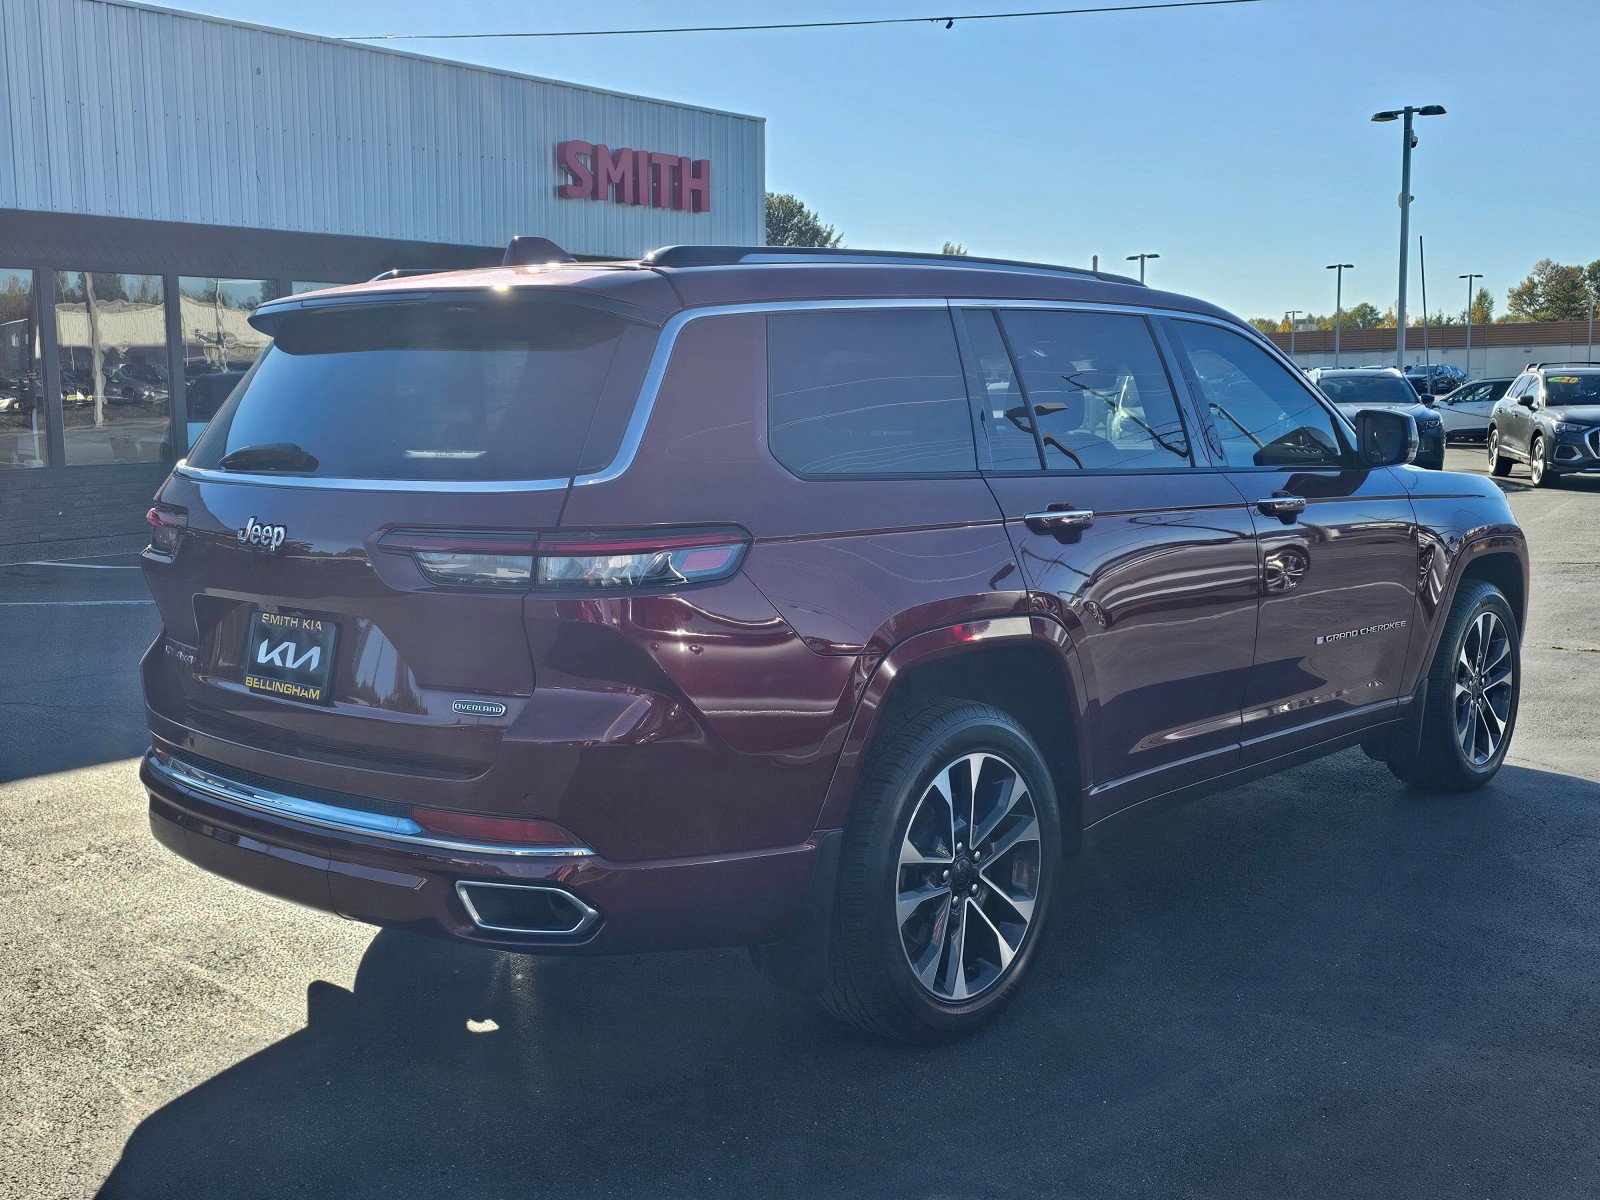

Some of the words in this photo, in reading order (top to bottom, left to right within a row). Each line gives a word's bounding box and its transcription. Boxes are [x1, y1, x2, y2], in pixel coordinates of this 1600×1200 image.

[557, 140, 710, 212] SMITH
[237, 516, 287, 552] Jeep
[261, 613, 299, 628] SMITH
[302, 618, 322, 631] KIA
[1325, 629, 1358, 642] GRAND
[1360, 620, 1407, 635] CHEROKEE
[257, 638, 321, 672] KIA
[245, 676, 320, 700] BELLINGHAM
[454, 703, 502, 713] OVERLAND
